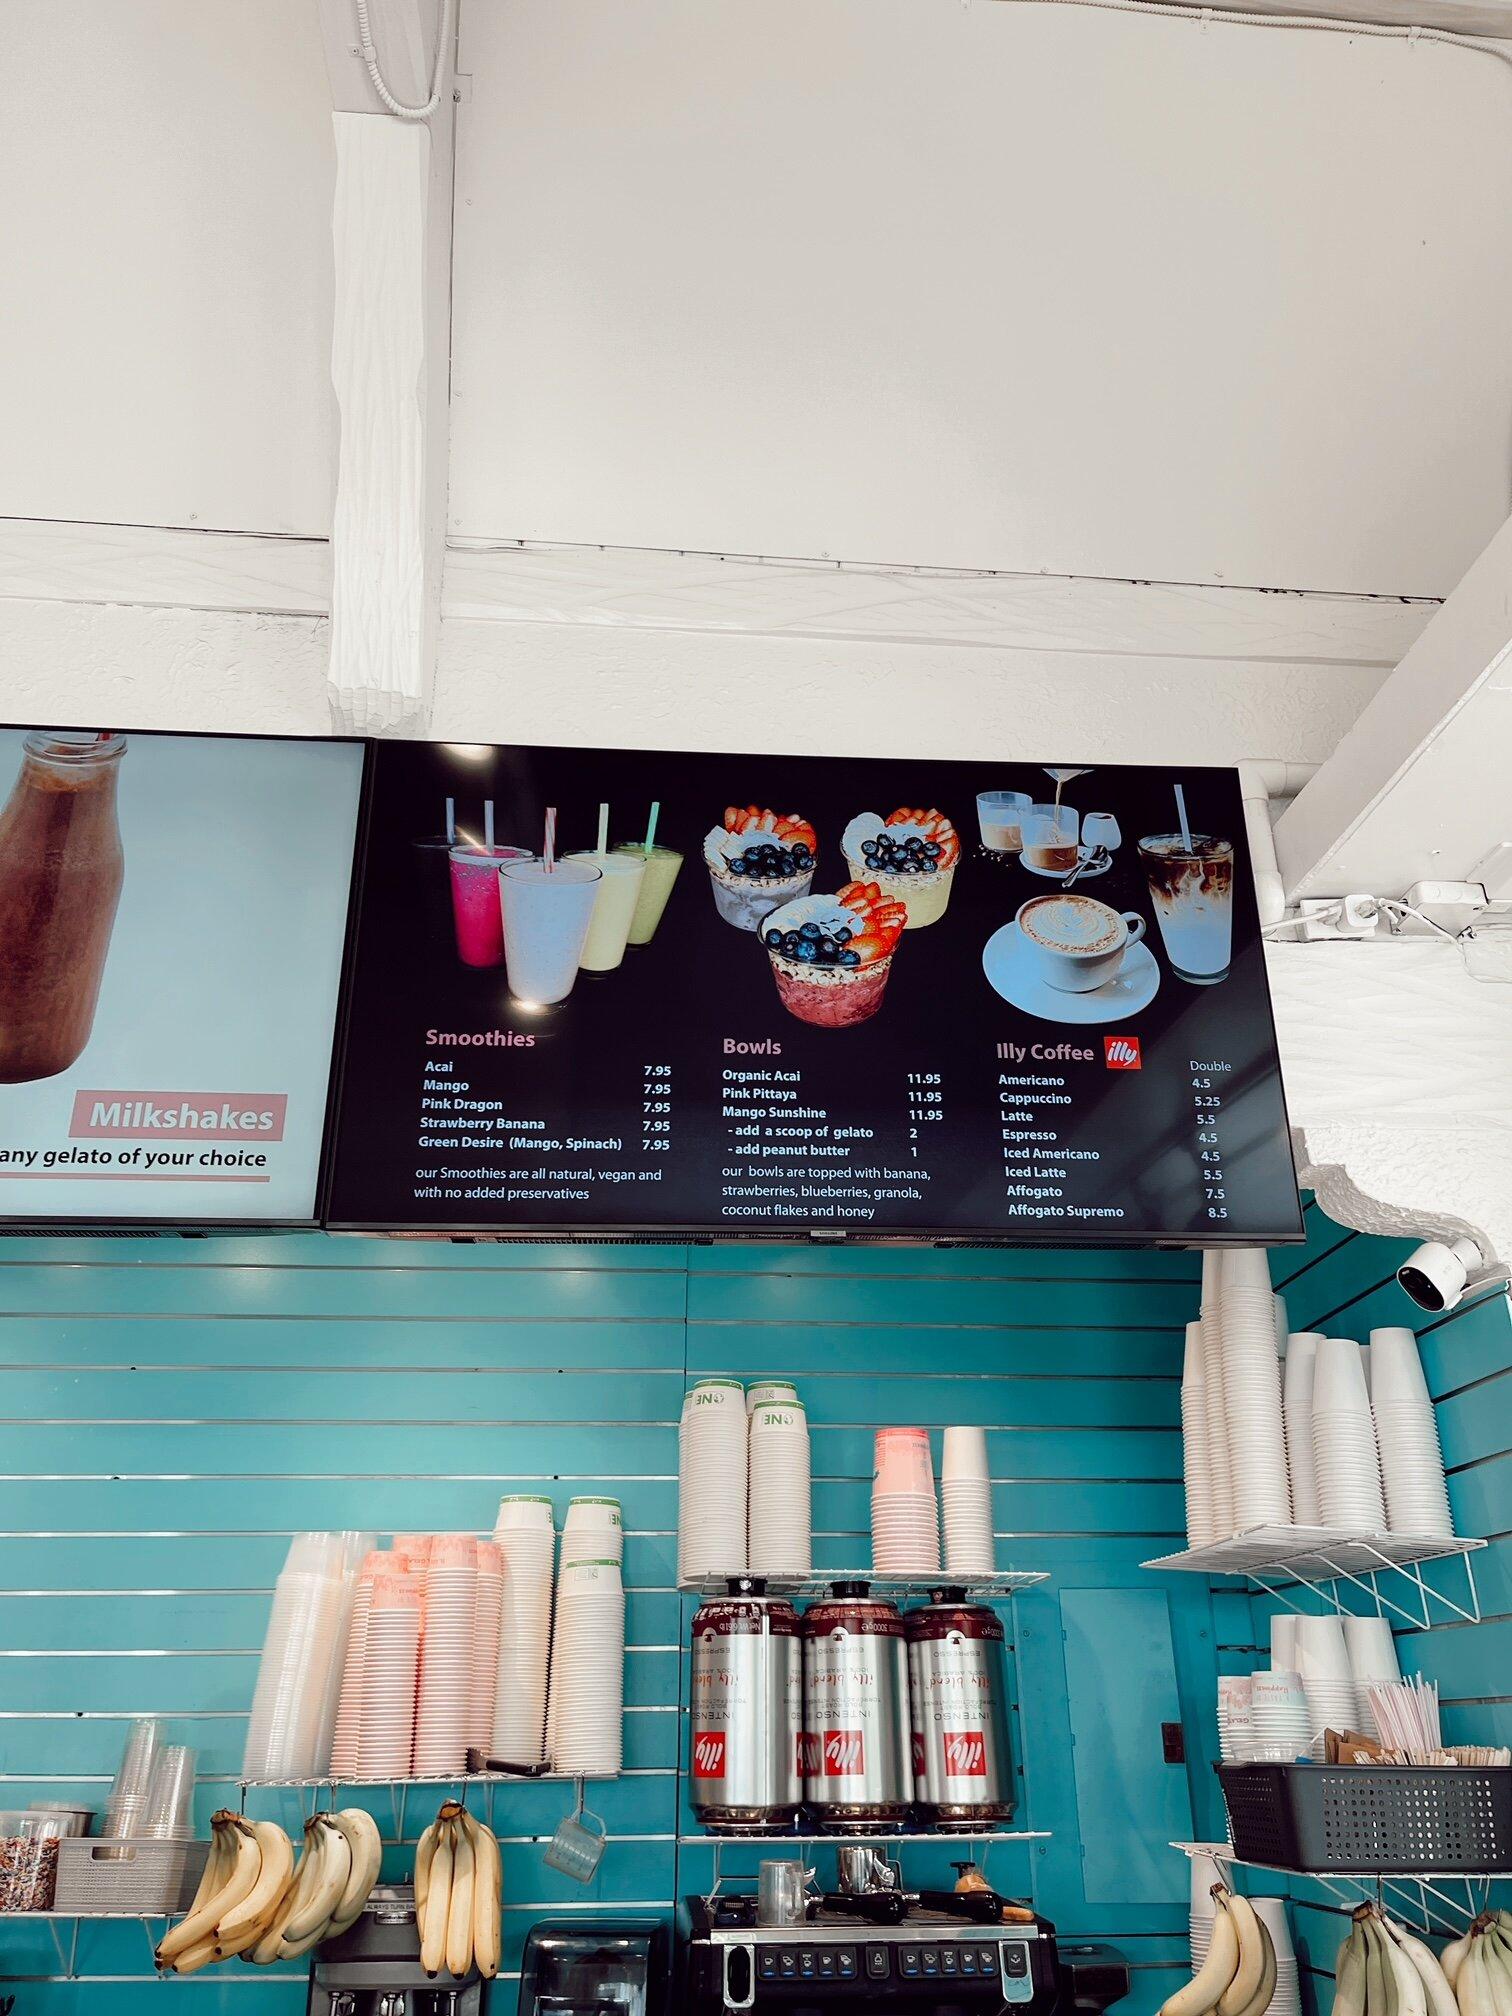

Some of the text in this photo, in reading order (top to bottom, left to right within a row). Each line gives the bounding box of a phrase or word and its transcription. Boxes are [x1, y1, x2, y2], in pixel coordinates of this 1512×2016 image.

[426, 1030, 536, 1047] Smoothies
[723, 1038, 781, 1055] Bowls
[997, 1044, 1094, 1062] Illy Coffee
[1108, 1042, 1137, 1066] illy
[424, 1061, 671, 1076] Acai 7.95
[1190, 1061, 1231, 1071] Double
[722, 1070, 941, 1084] Organic Acai 11.95
[999, 1075, 1210, 1088] Americano 4.5
[423, 1080, 671, 1094] Mango 7.95
[722, 1088, 942, 1102] Pink Pittaya 11.95
[1000, 1093, 1220, 1106] Cappuccino 5.25
[422, 1098, 670, 1113] Pink Dragon 7.95
[90, 1102, 274, 1129] Milkshakes
[722, 1107, 943, 1120] Mango Sunshine 11.95
[1001, 1111, 1215, 1124] Latte 5.5
[420, 1118, 670, 1131] Strawberry Banana 7.95
[735, 1126, 759, 1136] add
[765, 1129, 772, 1137] a
[775, 1128, 812, 1140] scoop
[815, 1127, 828, 1137] of
[834, 1127, 873, 1139] gelato
[910, 1129, 918, 1138] 2
[1003, 1130, 1217, 1143] Espresso 4.5
[418, 1136, 670, 1151] Green Desire (Mango, Spinach) 7.95
[0, 1147, 267, 1168] any gelato of your choice
[735, 1145, 760, 1155] add
[763, 1146, 808, 1157] peanut
[810, 1146, 850, 1156] butter
[911, 1147, 917, 1157] 1
[1004, 1148, 1220, 1161] Iced Americano 4.5
[416, 1168, 662, 1182] our Smoothies are all natural, vegan and
[722, 1166, 931, 1180] our bowls are topped with banana,
[1005, 1167, 1222, 1180] Iced Latte 5.5
[414, 1187, 589, 1201] with no added preservatives
[722, 1186, 922, 1200] strawberries, blueberries, granola,
[1007, 1186, 1225, 1198] Affogato 7.5
[722, 1205, 875, 1219] coconut flakes and honey
[1008, 1205, 1227, 1218] Affogato Supremo 8.5
[816, 1710, 871, 1719] INTENSO
[933, 1712, 989, 1721] INTENSO
[695, 1736, 724, 1771] illy
[826, 1734, 861, 1769] illy
[947, 1735, 982, 1770] illy
